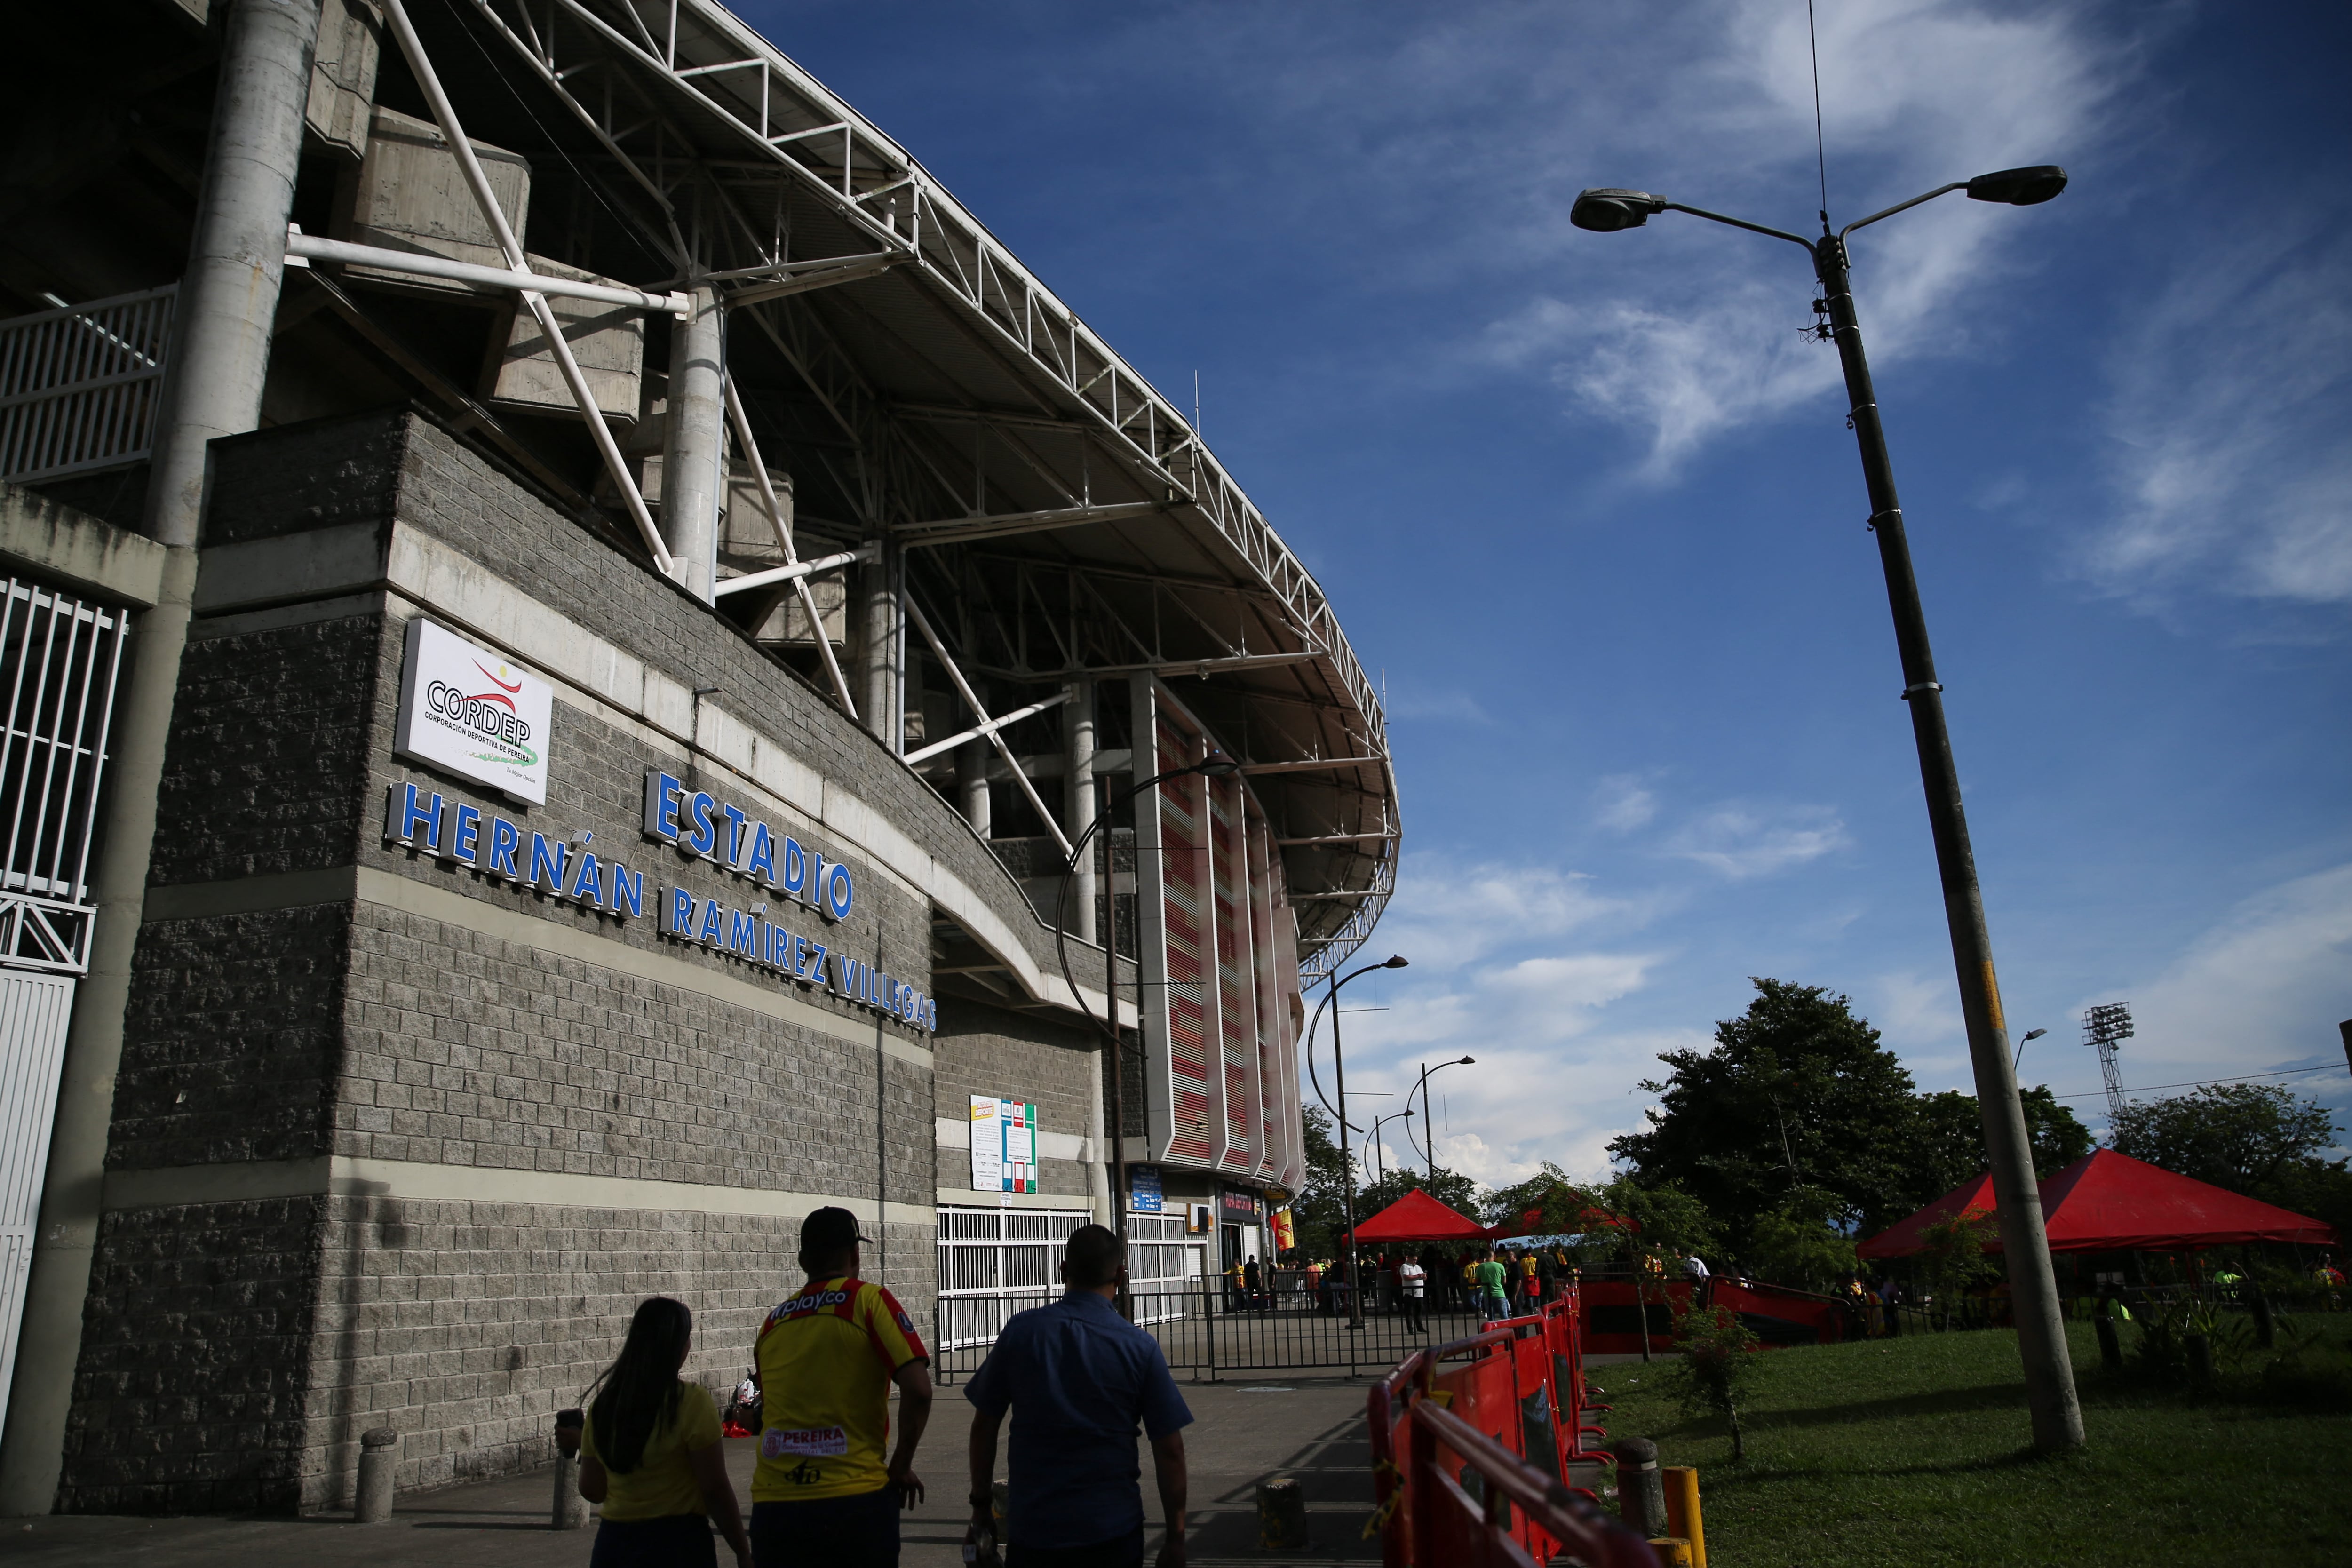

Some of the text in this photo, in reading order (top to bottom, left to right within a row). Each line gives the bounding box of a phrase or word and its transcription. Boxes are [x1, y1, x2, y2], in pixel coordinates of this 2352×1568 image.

[425, 711, 530, 764] CORPORACIÓN DEPORTIVA DE PEREIRA
[427, 680, 531, 748] CORDEP
[512, 769, 523, 779] Mejor
[523, 774, 536, 784] Opción
[655, 770, 853, 919] ESTADIO
[398, 781, 936, 1032] HERNÁN RAMÍREZ VILLEGAS
[783, 1427, 844, 1443] PEREIRA
